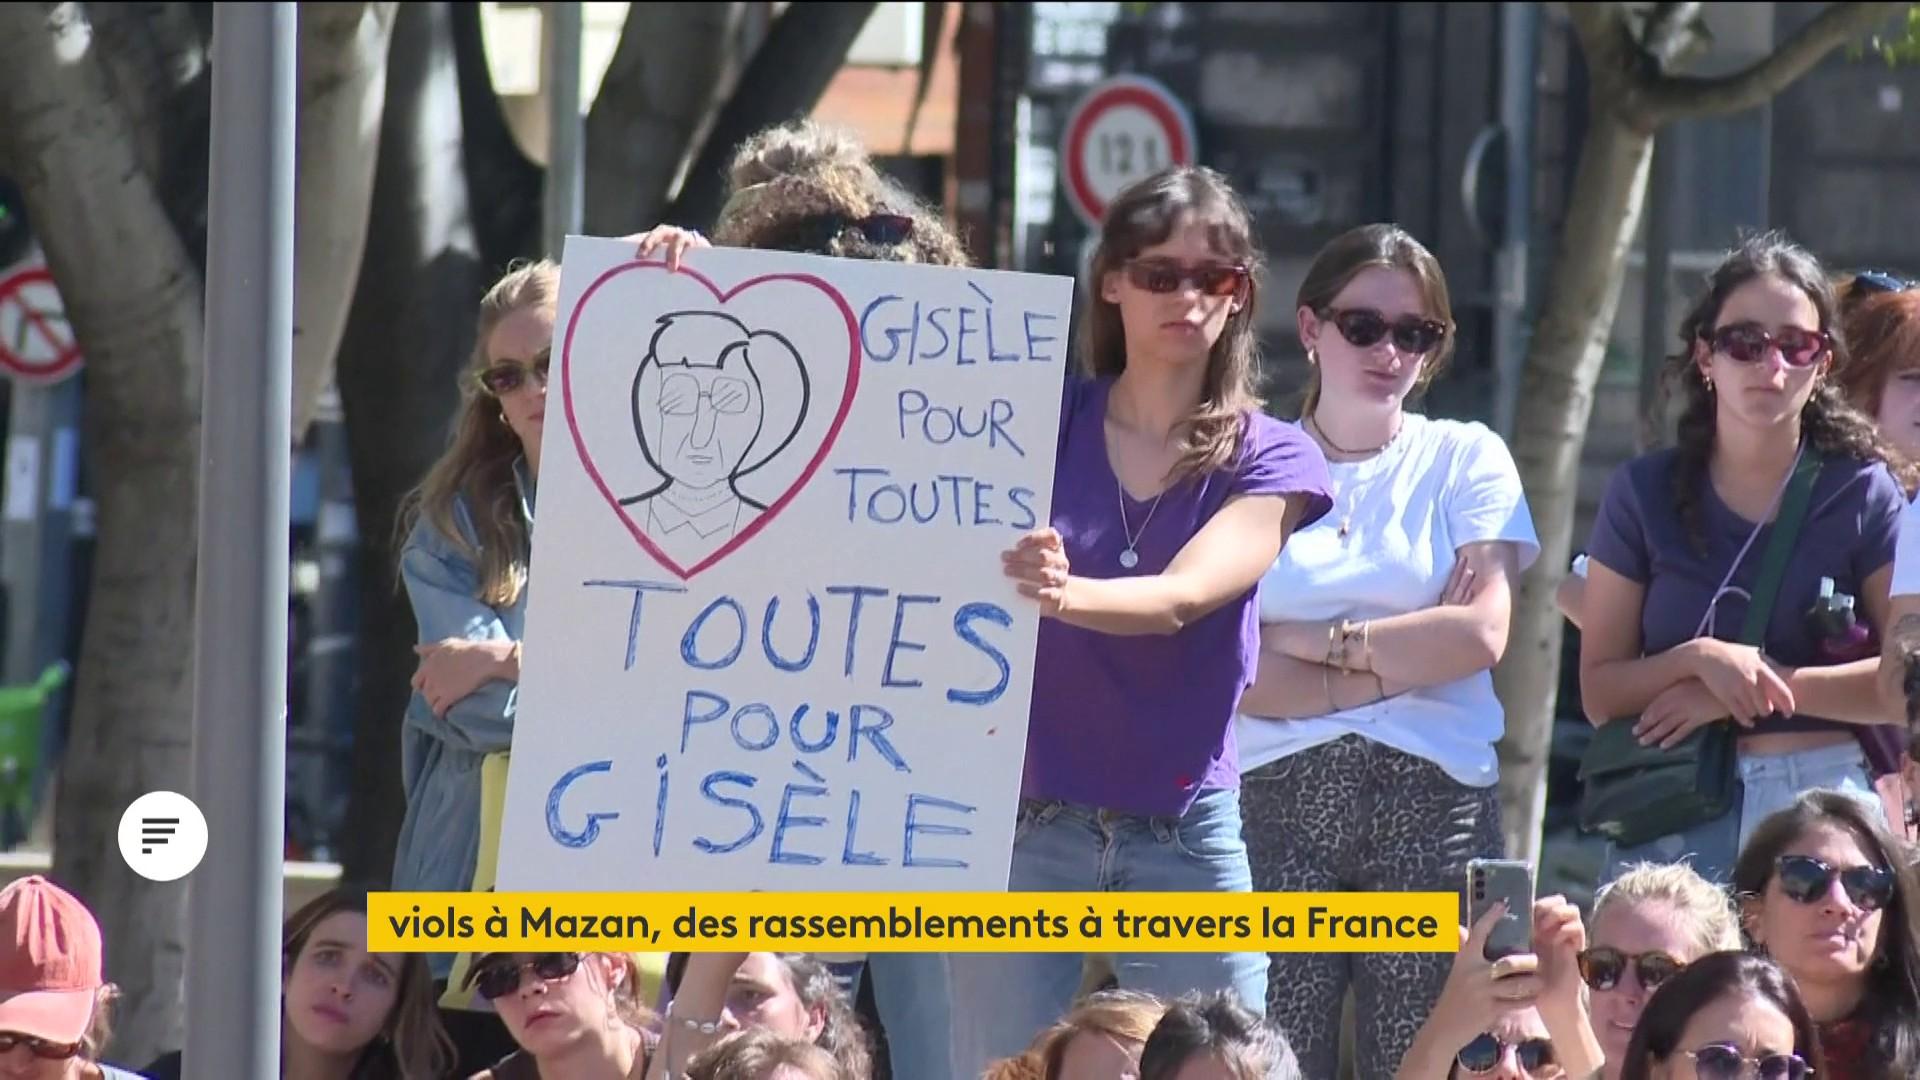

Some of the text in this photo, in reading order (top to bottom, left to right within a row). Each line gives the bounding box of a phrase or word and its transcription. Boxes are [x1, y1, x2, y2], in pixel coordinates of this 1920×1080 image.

[860, 280, 1057, 365] GISÈLE
[898, 389, 1025, 457] POUR
[833, 467, 1036, 530] TOUTES
[583, 579, 1014, 705] TOUTES
[681, 690, 911, 773] POUR
